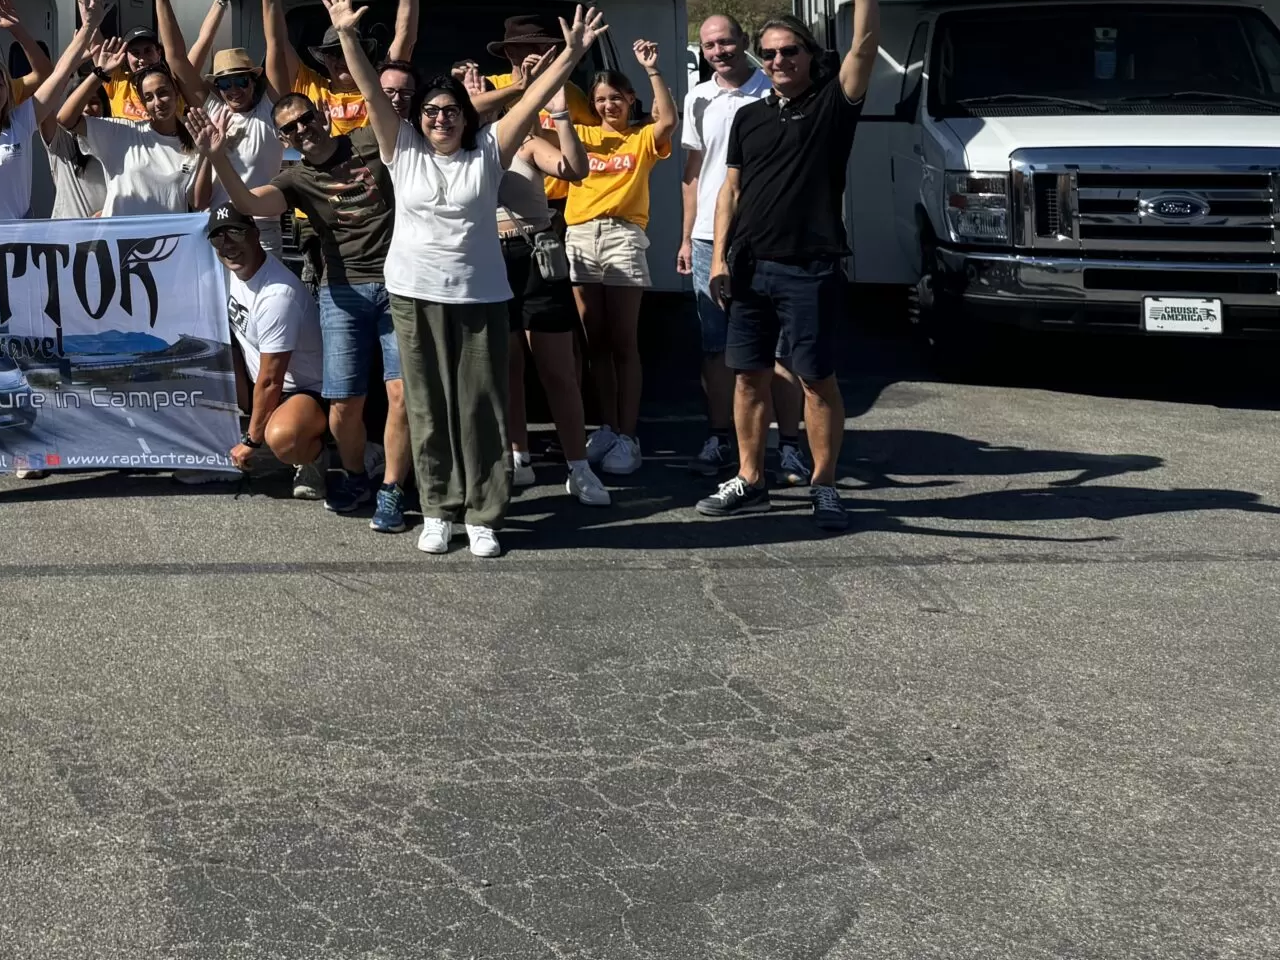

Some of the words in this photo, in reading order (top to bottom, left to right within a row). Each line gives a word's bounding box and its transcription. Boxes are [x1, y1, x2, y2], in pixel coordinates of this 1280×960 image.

[1164, 306, 1199, 314] CRUISE
[1160, 313, 1204, 322] AMERICA
[54, 386, 80, 409] in
[90, 387, 203, 412] Camper
